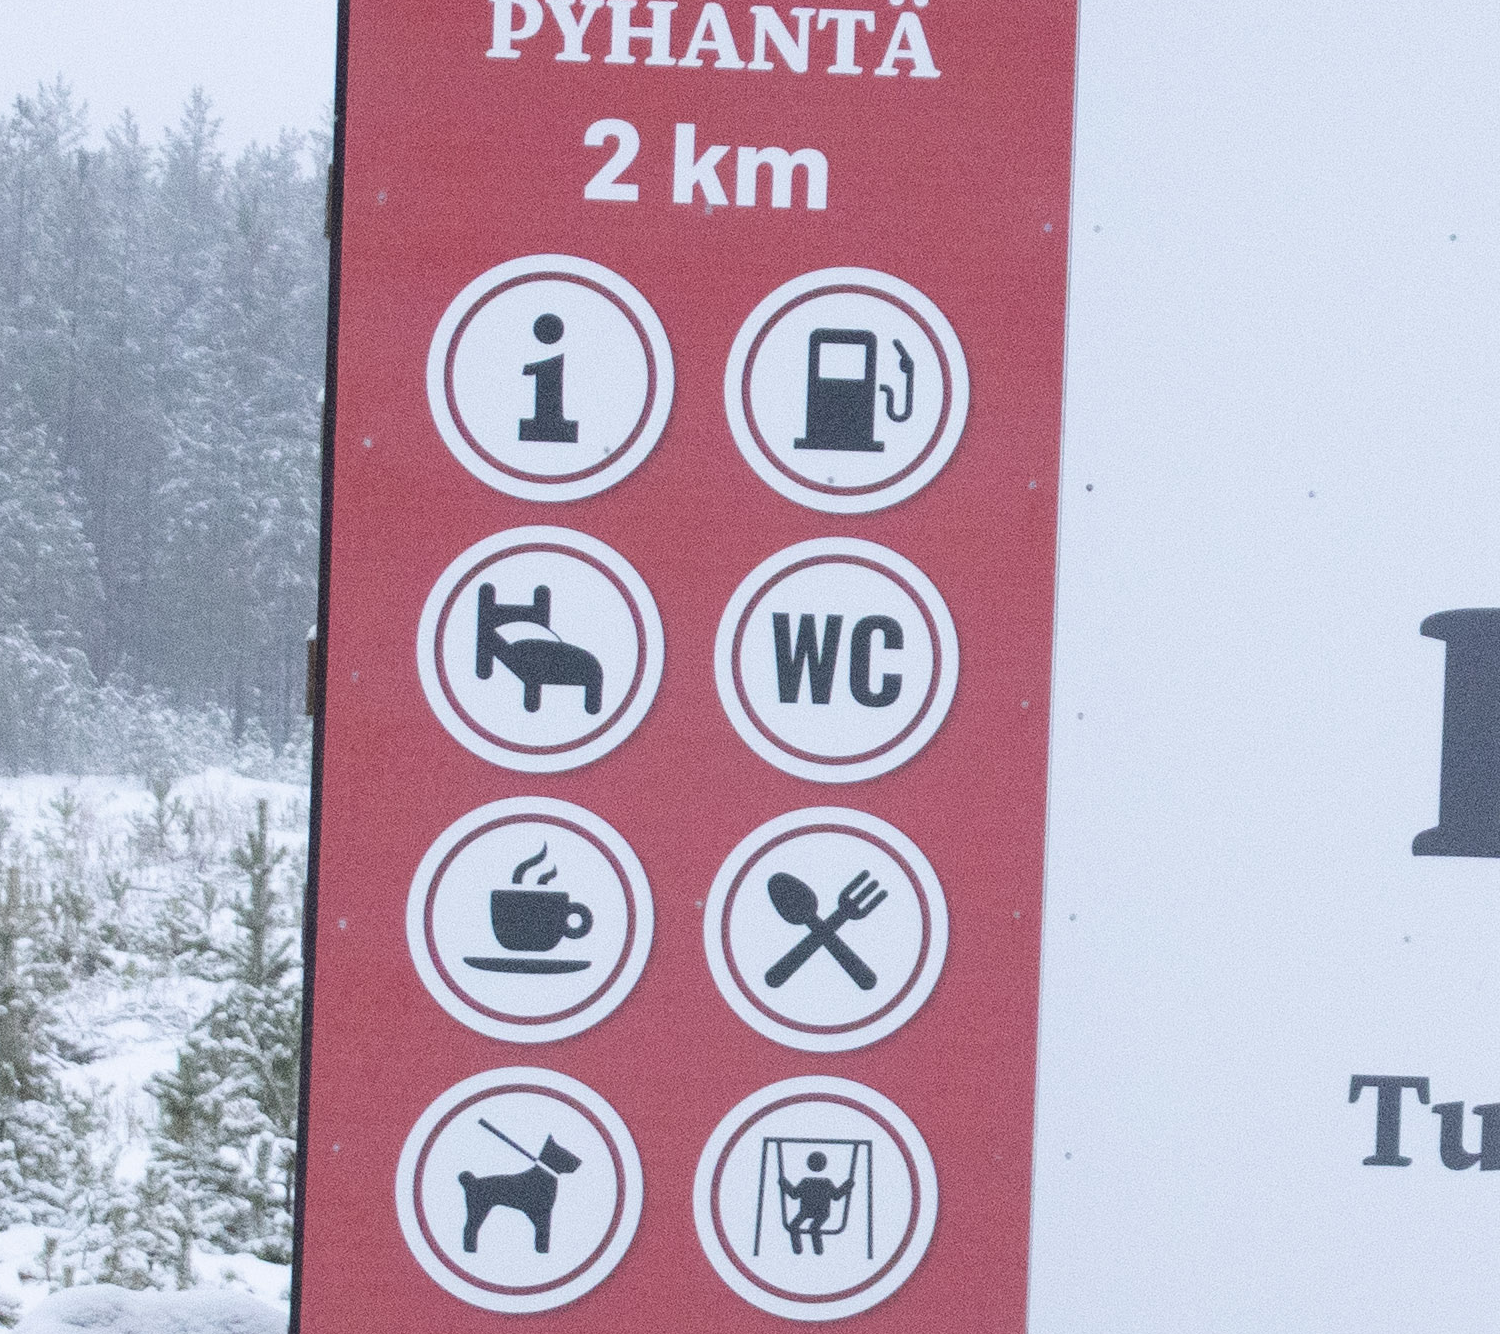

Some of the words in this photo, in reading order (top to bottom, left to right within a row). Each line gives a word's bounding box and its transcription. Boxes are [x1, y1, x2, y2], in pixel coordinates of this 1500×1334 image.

[584, 119, 639, 202] 2
[673, 123, 828, 210] km
[773, 613, 903, 708] WC
